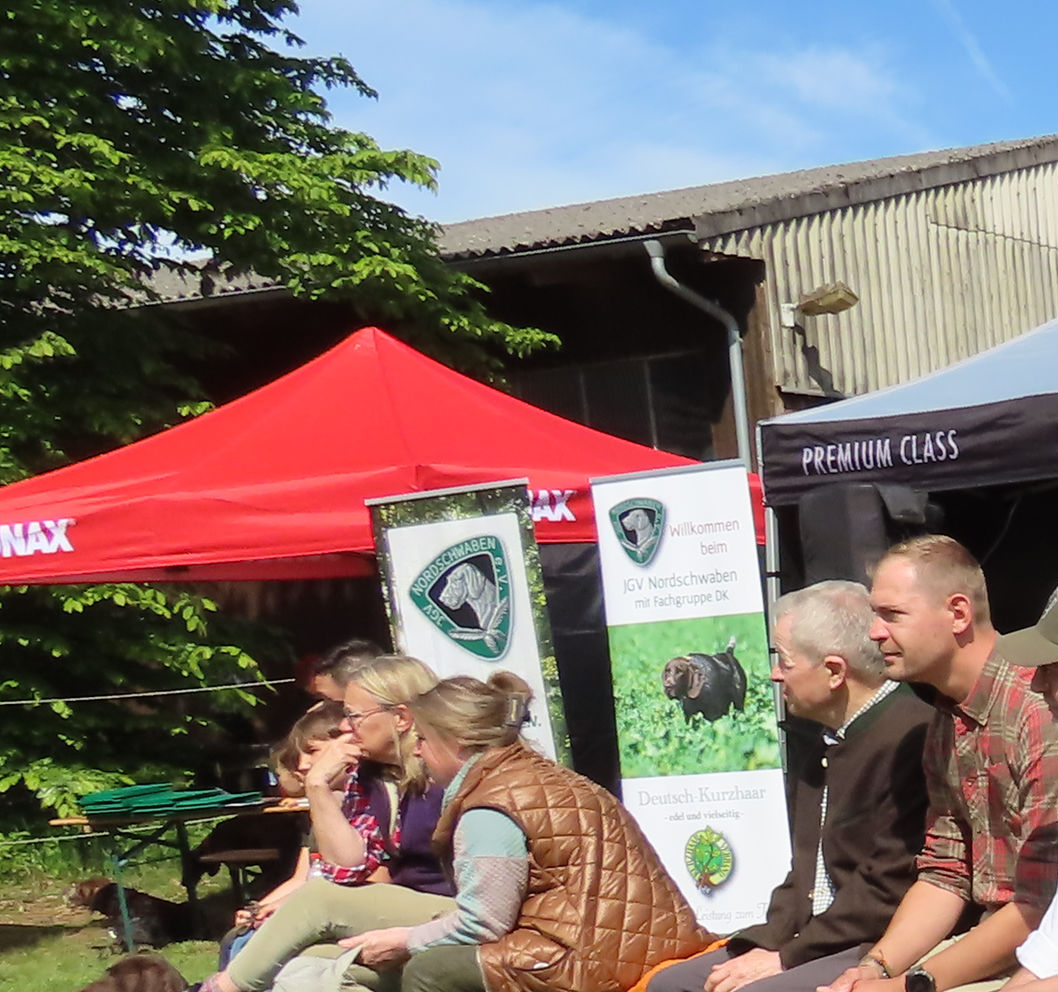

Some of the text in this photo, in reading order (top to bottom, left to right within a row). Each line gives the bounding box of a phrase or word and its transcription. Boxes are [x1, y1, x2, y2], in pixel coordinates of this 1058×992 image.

[801, 429, 959, 476] PREMIUM CLASS
[526, 489, 578, 522] AX
[0, 518, 76, 558] NAX
[669, 519, 740, 537] Willkommen
[700, 541, 728, 556] beim
[411, 537, 496, 596] NORDSCHWABEN
[623, 568, 737, 594] JGV Nordschwaben
[635, 589, 730, 609] mit Fachgruppe DK
[686, 811, 702, 821] und
